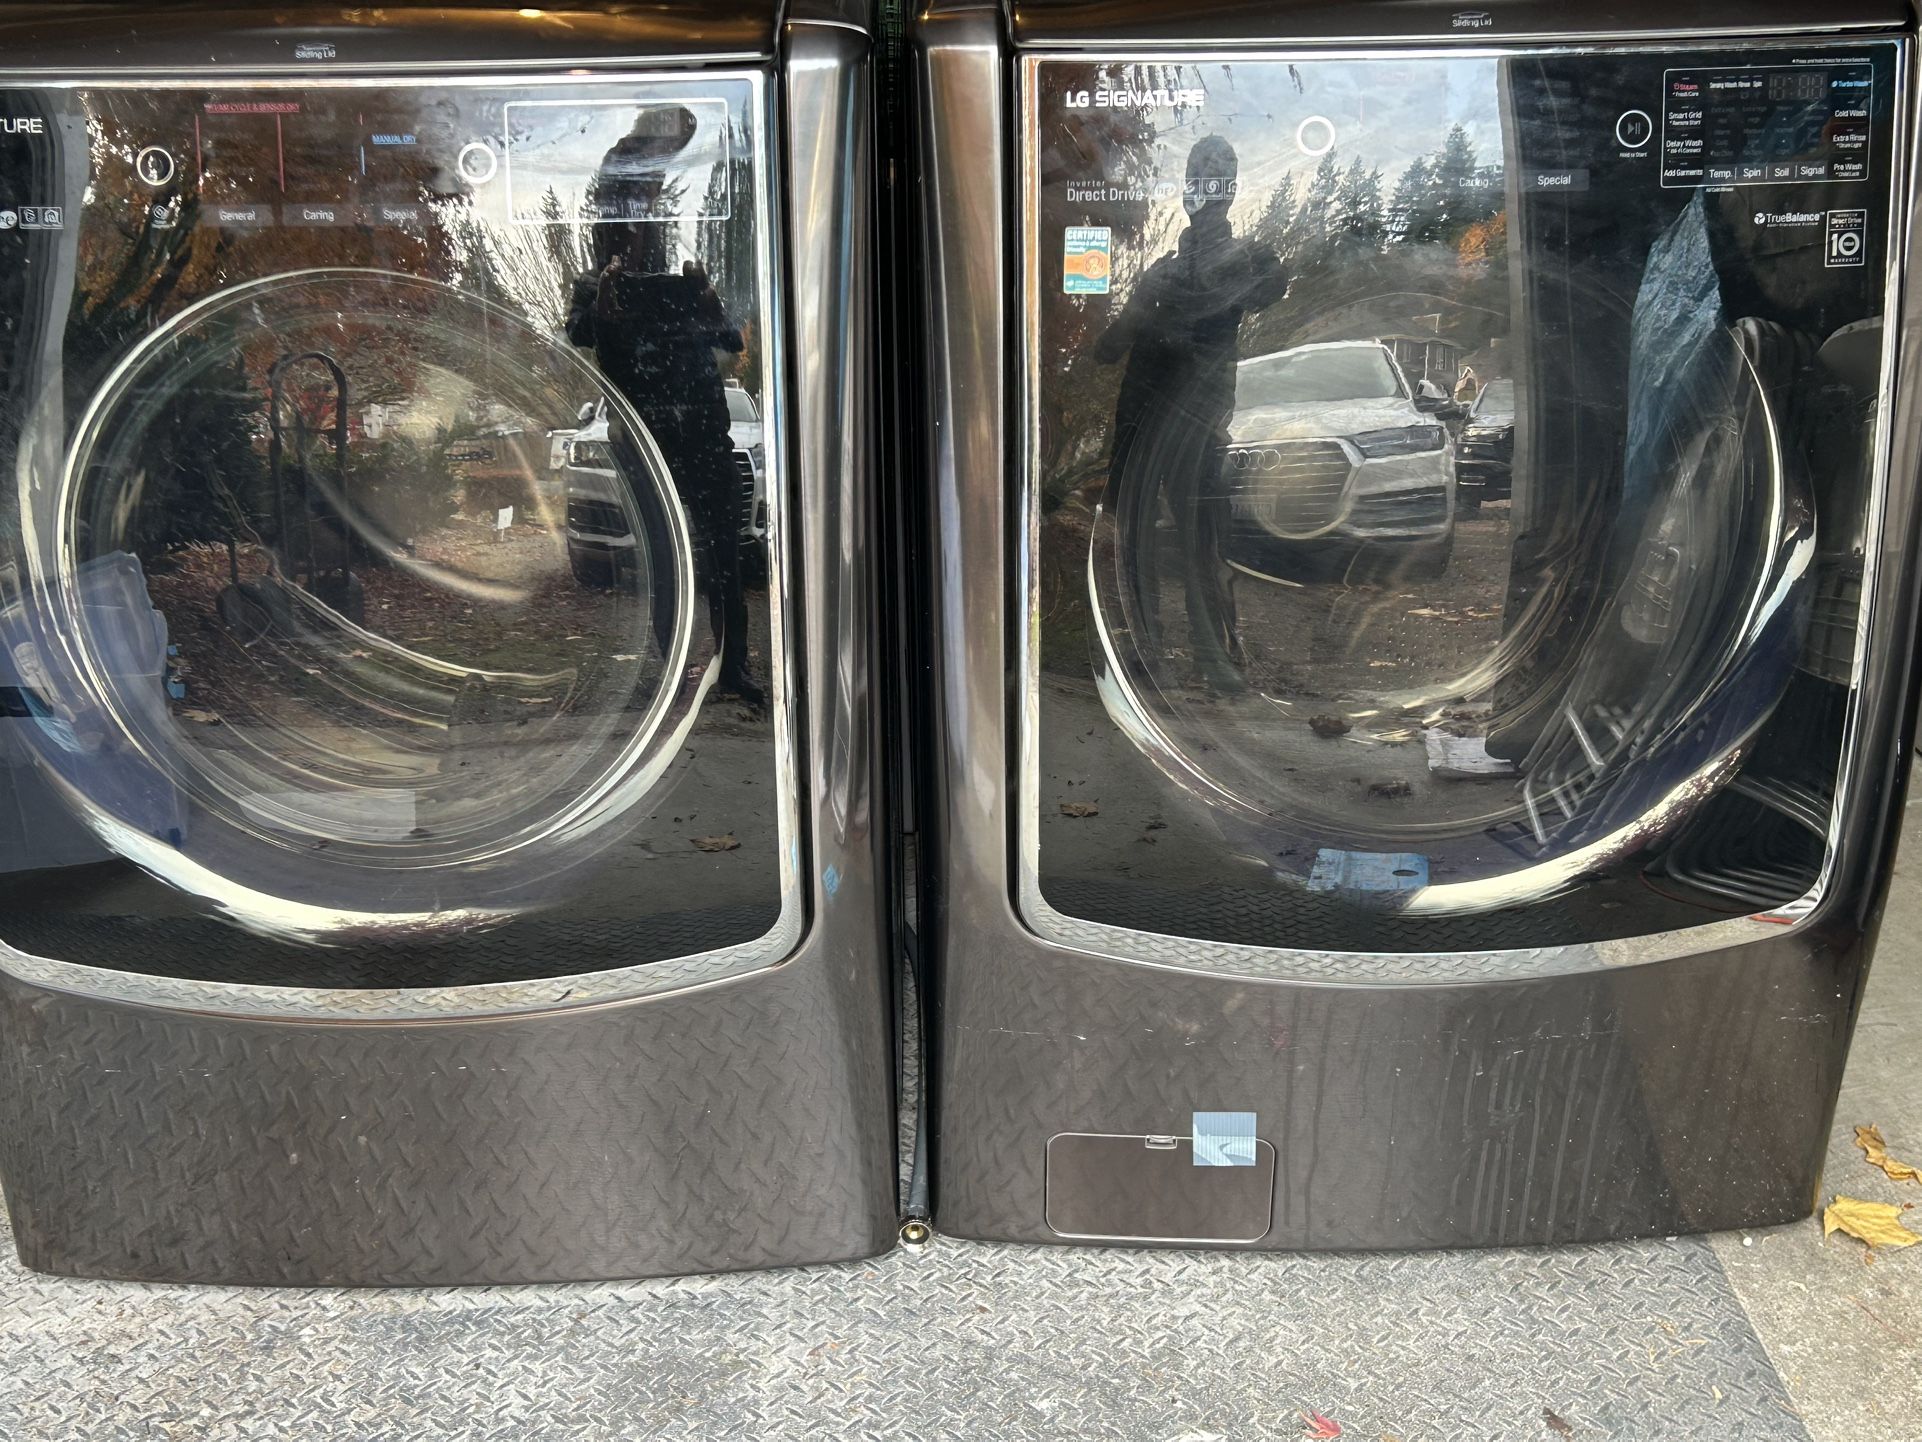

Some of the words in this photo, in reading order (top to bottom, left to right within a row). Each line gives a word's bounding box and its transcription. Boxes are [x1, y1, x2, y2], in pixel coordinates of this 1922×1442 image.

[1452, 19, 1479, 28] Sliding
[1480, 17, 1492, 26] Lid
[295, 50, 323, 60] Sliding
[1066, 90, 1090, 108] LG
[1095, 88, 1205, 107] SIGNATURE
[1669, 112, 1688, 120] Smart
[1688, 110, 1703, 119] Grid
[1849, 109, 1867, 117] Wash
[372, 134, 402, 143] MANUAL
[403, 134, 417, 143] DRY
[1849, 134, 1867, 142] Rinse
[1666, 140, 1684, 149] Delay
[1685, 139, 1703, 147] Wash
[1800, 166, 1825, 177] Signal
[1834, 163, 1844, 171] Pre
[1664, 169, 1676, 177] Add
[1676, 169, 1704, 177] Garments
[1709, 169, 1733, 180] Temp.
[1743, 168, 1761, 179] Spin
[1774, 168, 1790, 178] Soil
[1066, 180, 1106, 188] Inverter
[1537, 174, 1572, 188] Special
[1067, 188, 1106, 202] Direct
[1110, 188, 1144, 201] Drive
[628, 200, 649, 210] Time
[219, 209, 256, 221] General
[303, 210, 335, 222] Caring
[383, 209, 418, 222] Special
[1067, 230, 1108, 240] CERTIFIED
[1831, 232, 1860, 257] 10
